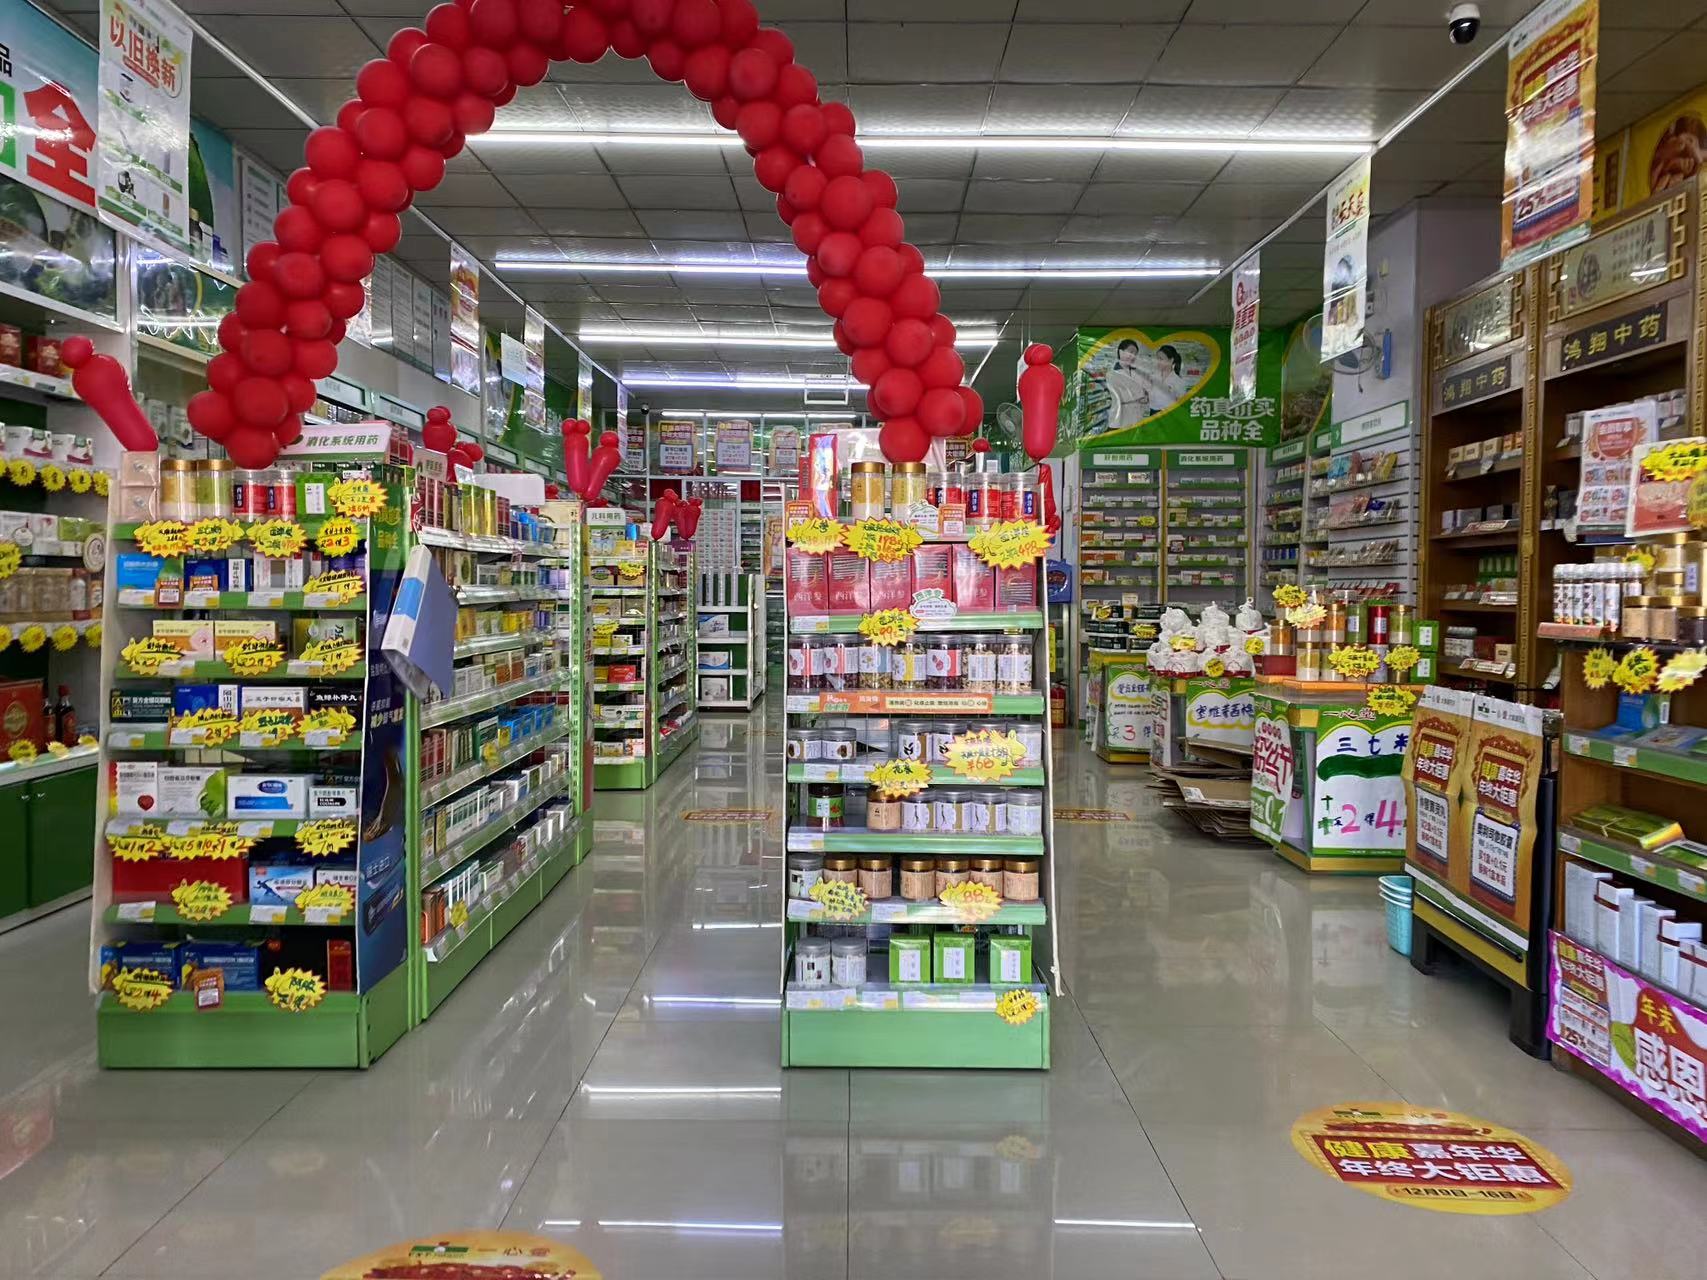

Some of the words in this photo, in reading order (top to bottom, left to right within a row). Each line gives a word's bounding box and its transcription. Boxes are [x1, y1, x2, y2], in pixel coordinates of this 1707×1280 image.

[306, 435, 379, 447] 消化系统用药
[1200, 420, 1264, 441] 品种全
[1478, 779, 1518, 809] 年终大钜惠
[1323, 1138, 1526, 1164] 健康嘉年华
[1338, 1158, 1552, 1185] 年终大钜惠
